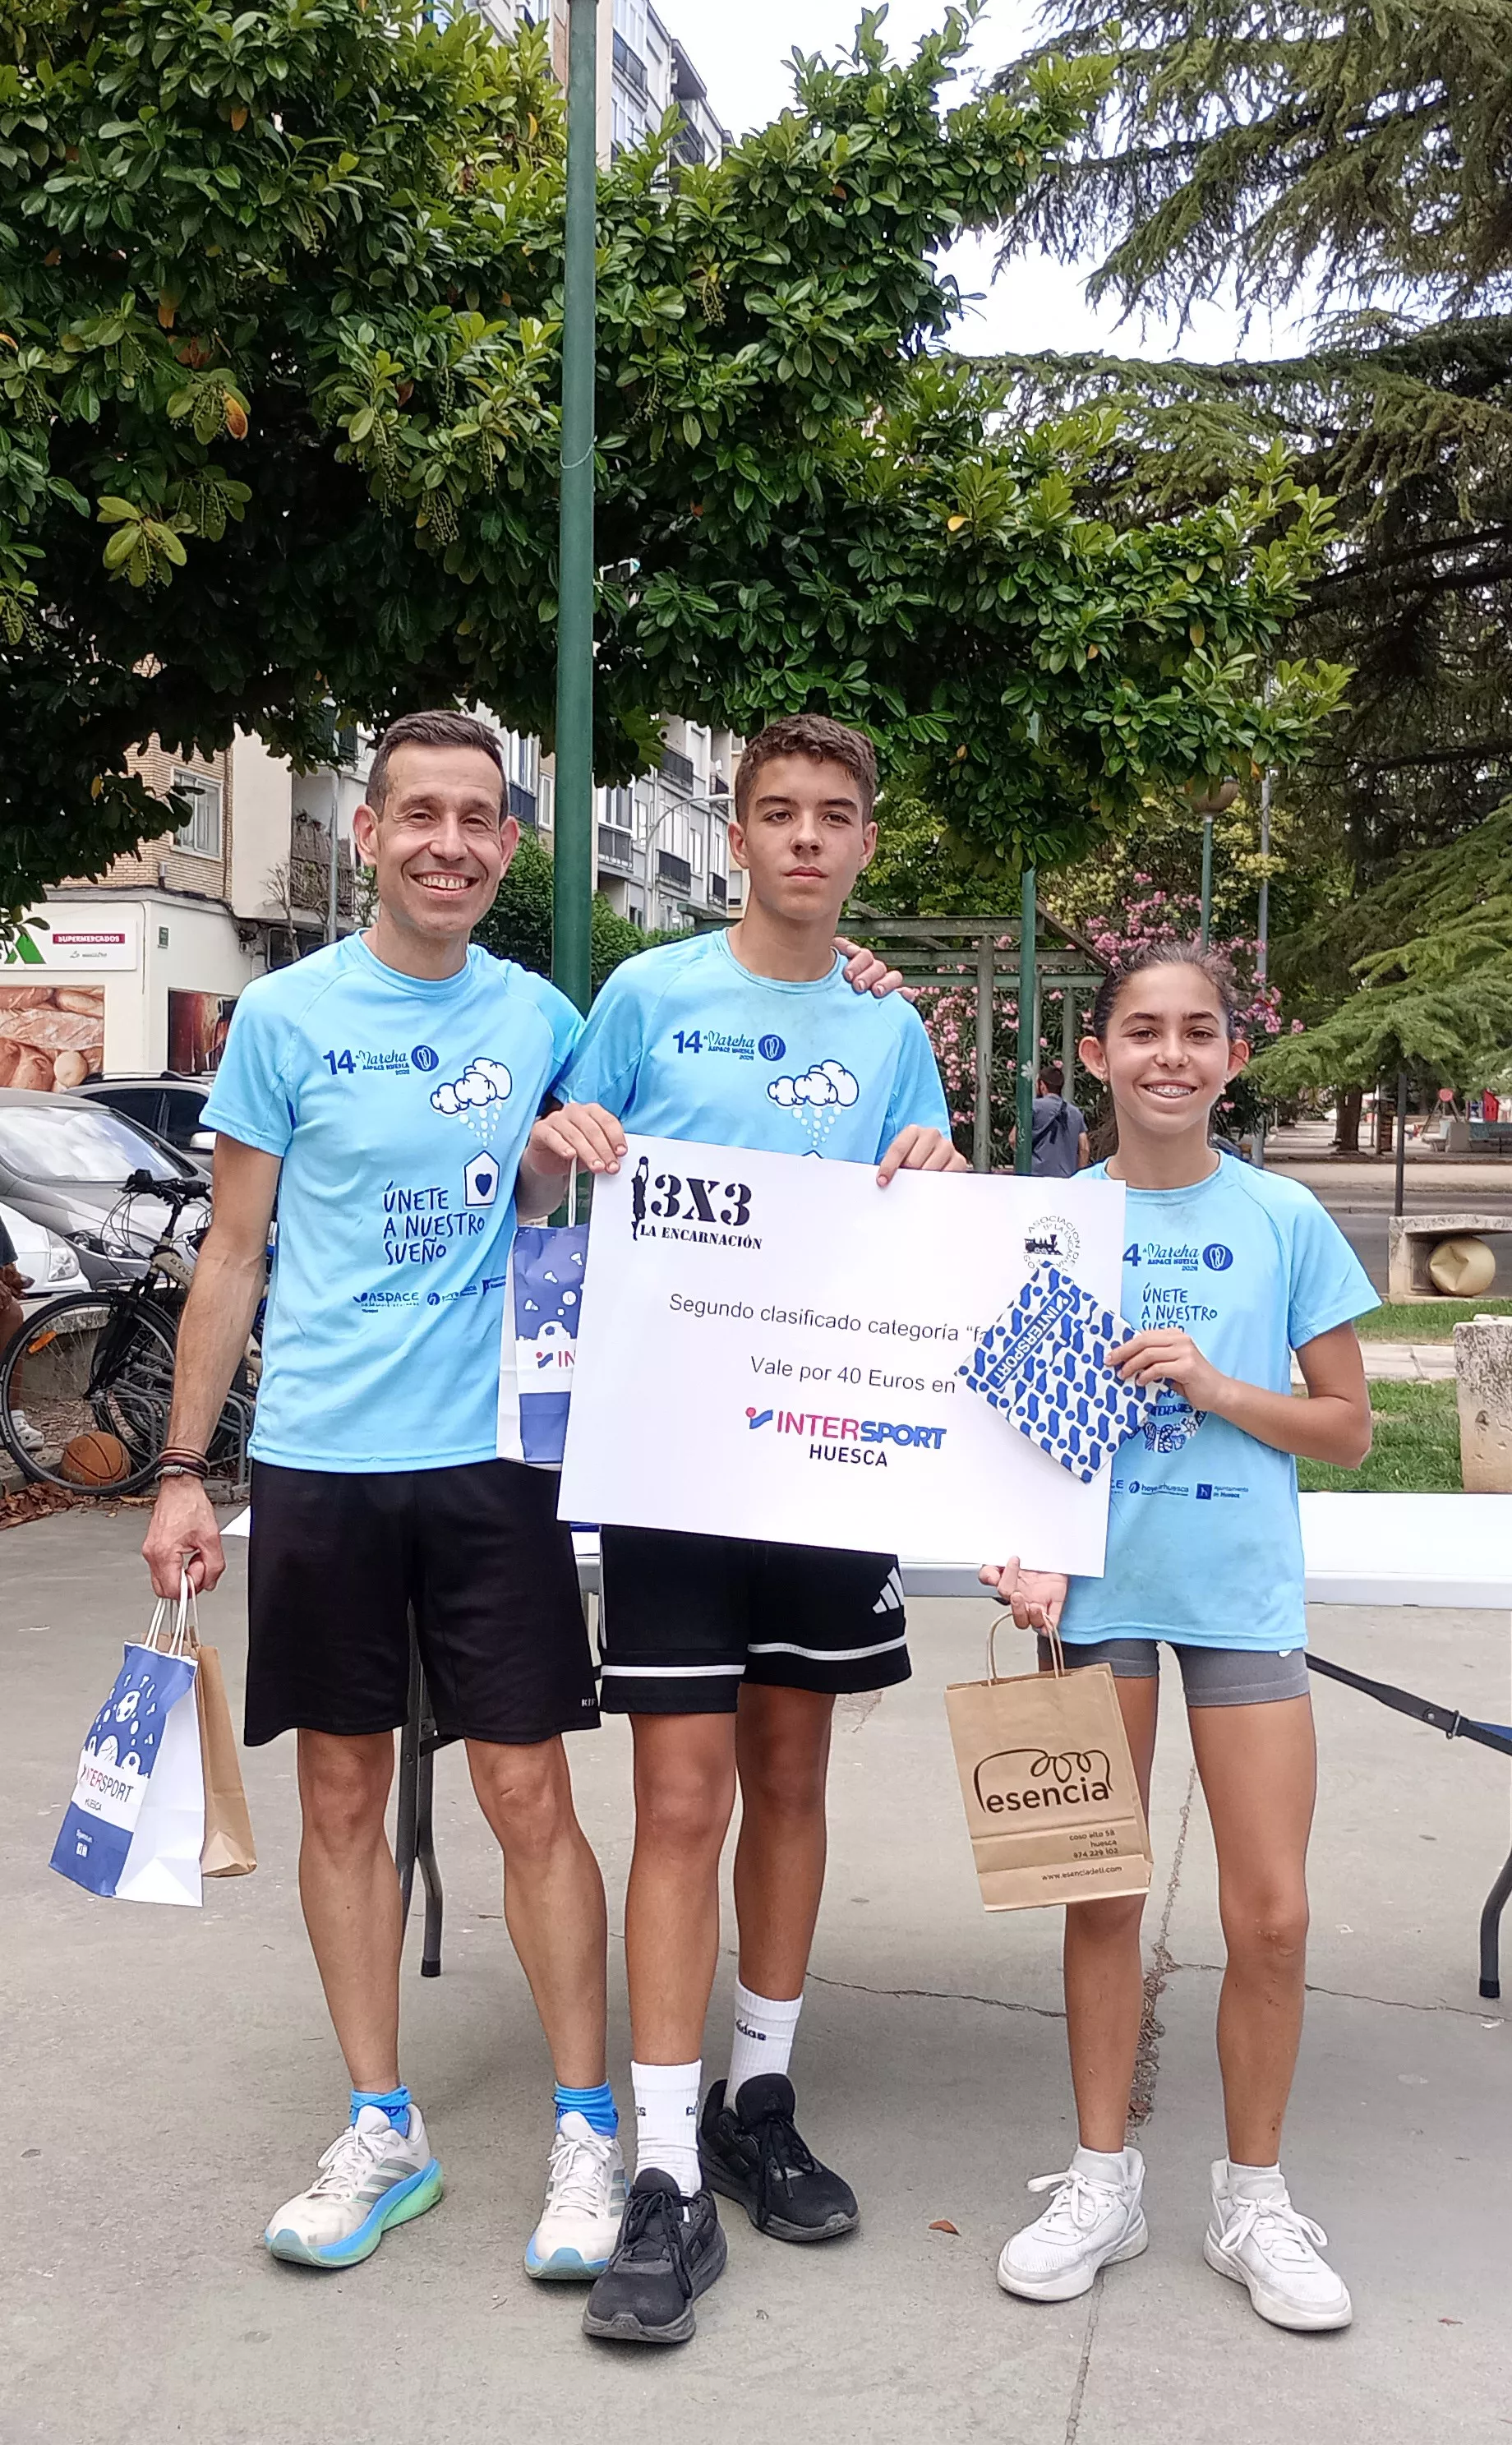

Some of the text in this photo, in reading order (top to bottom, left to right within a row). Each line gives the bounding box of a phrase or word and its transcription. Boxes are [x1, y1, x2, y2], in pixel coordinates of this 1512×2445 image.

[384, 1179, 449, 1213] ÚNETE
[650, 1174, 752, 1226] 3X3
[383, 1212, 485, 1239] A NUESTRO
[640, 1225, 763, 1249] LA ENCARNACIÓN
[385, 1237, 447, 1265] SUEÑO
[1142, 1282, 1188, 1304] ÚNETE
[669, 1294, 754, 1318] Segundo
[760, 1305, 862, 1332] clasificado
[868, 1319, 959, 1342] categoría
[1141, 1304, 1218, 1322] A NUESTRO
[993, 1305, 1060, 1386] INTERSPORT
[750, 1356, 957, 1394] Vale por 40 Euros en
[777, 1410, 947, 1450] INTERSPORT
[809, 1443, 888, 1468] HUESCA
[985, 1777, 1109, 1814] esencia
